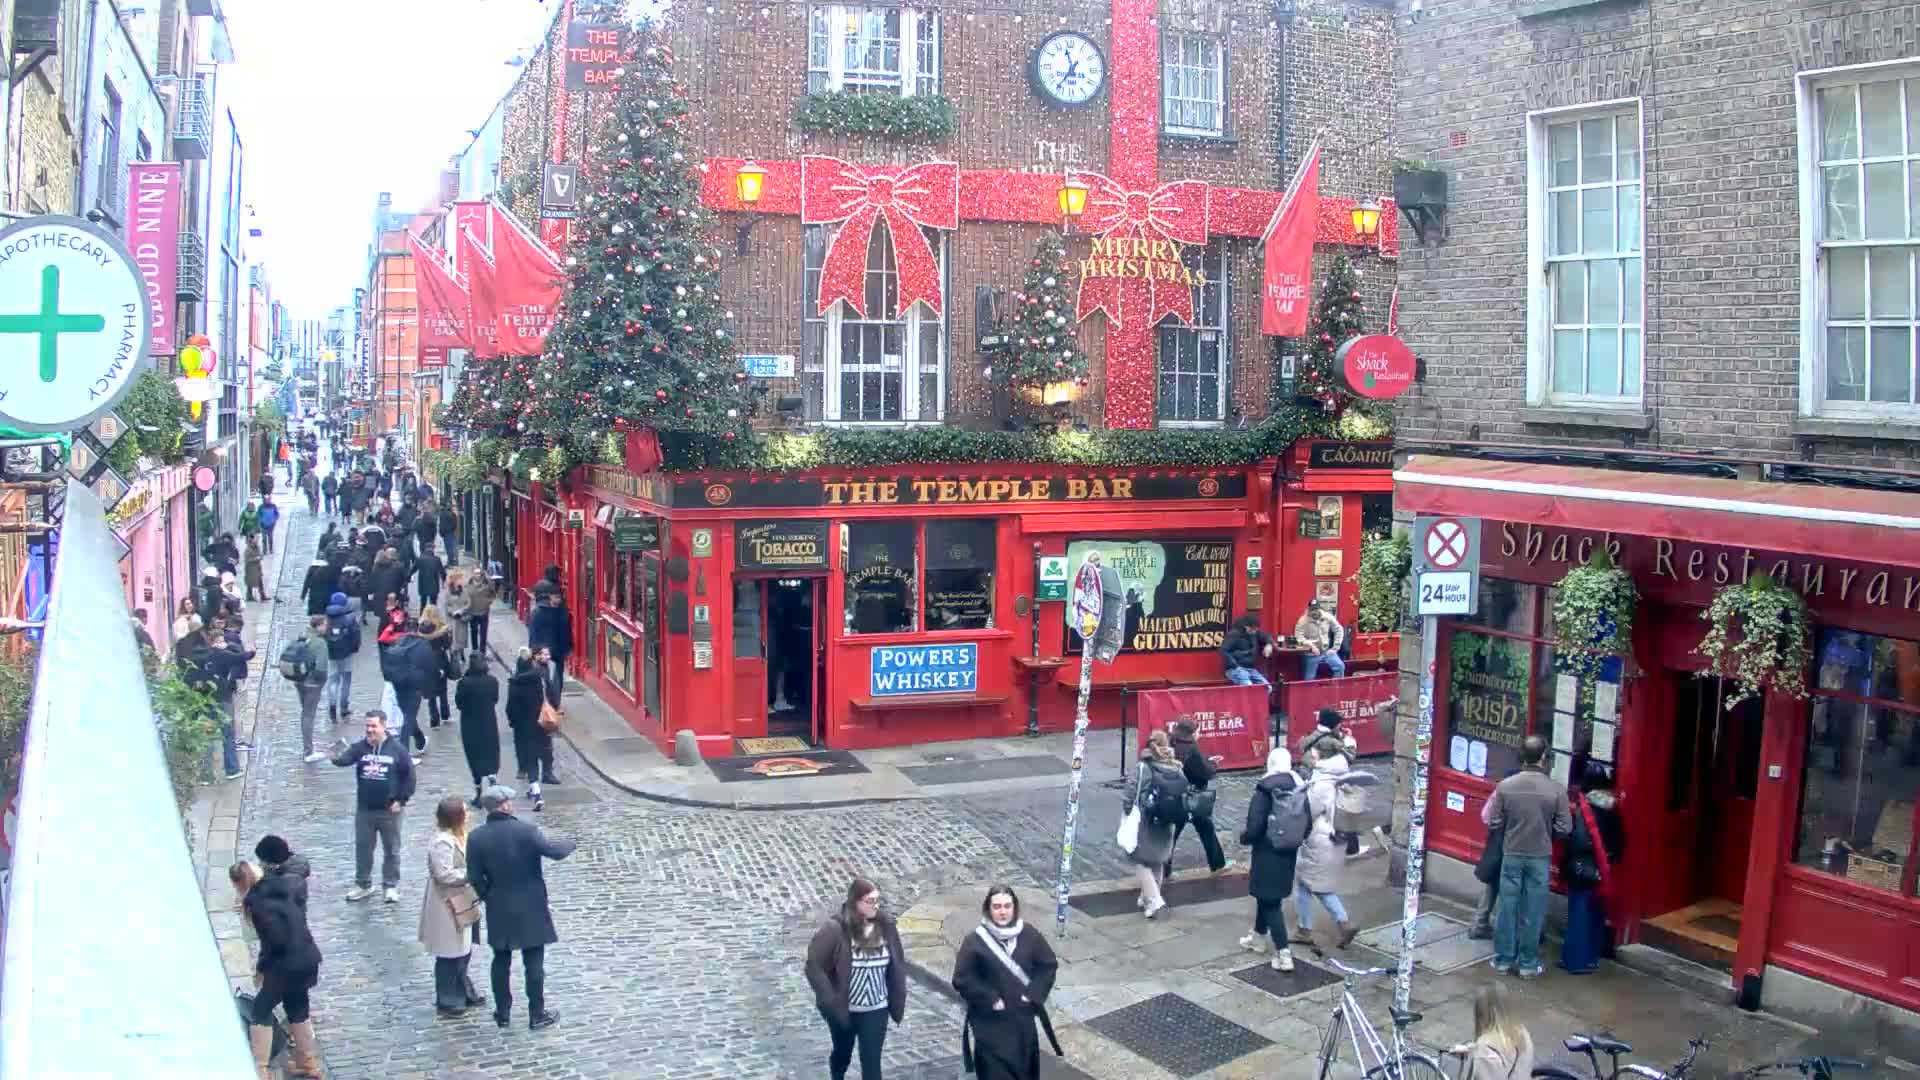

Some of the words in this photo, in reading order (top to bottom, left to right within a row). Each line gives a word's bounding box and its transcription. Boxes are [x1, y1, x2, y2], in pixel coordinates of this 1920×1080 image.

[586, 30, 618, 45] THE
[569, 48, 624, 64] TEMPL
[137, 171, 169, 233] NINE
[1091, 237, 1185, 262] MERRY
[520, 304, 546, 314] THE
[423, 319, 465, 329] TEMPLE
[517, 327, 548, 337] BAR
[88, 303, 136, 401] PHARMACY
[1356, 350, 1389, 370] Shack
[823, 482, 899, 504] THE
[913, 480, 1050, 501] TEMPLE
[1066, 478, 1134, 498] BAR
[1122, 546, 1148, 558] THE
[1501, 520, 1621, 569] Shack
[875, 554, 889, 562] THE
[1112, 557, 1157, 569] TEMPLE
[848, 565, 893, 588] TEMPLE
[894, 570, 914, 586] BAR
[1122, 567, 1146, 579] BAR
[1203, 563, 1227, 578] THE
[1176, 578, 1227, 593] EMPEROR
[1211, 594, 1226, 608] OF
[1422, 584, 1444, 603] 24
[1444, 593, 1467, 602] HOUR
[1138, 615, 1183, 633] MALTED
[1184, 608, 1227, 629] LIQUORS
[1133, 631, 1225, 651] GUINNESS
[880, 648, 970, 668] POWER'S
[874, 670, 975, 690] WHISKEY
[1195, 712, 1215, 721] THE
[1219, 718, 1245, 730] BAR
